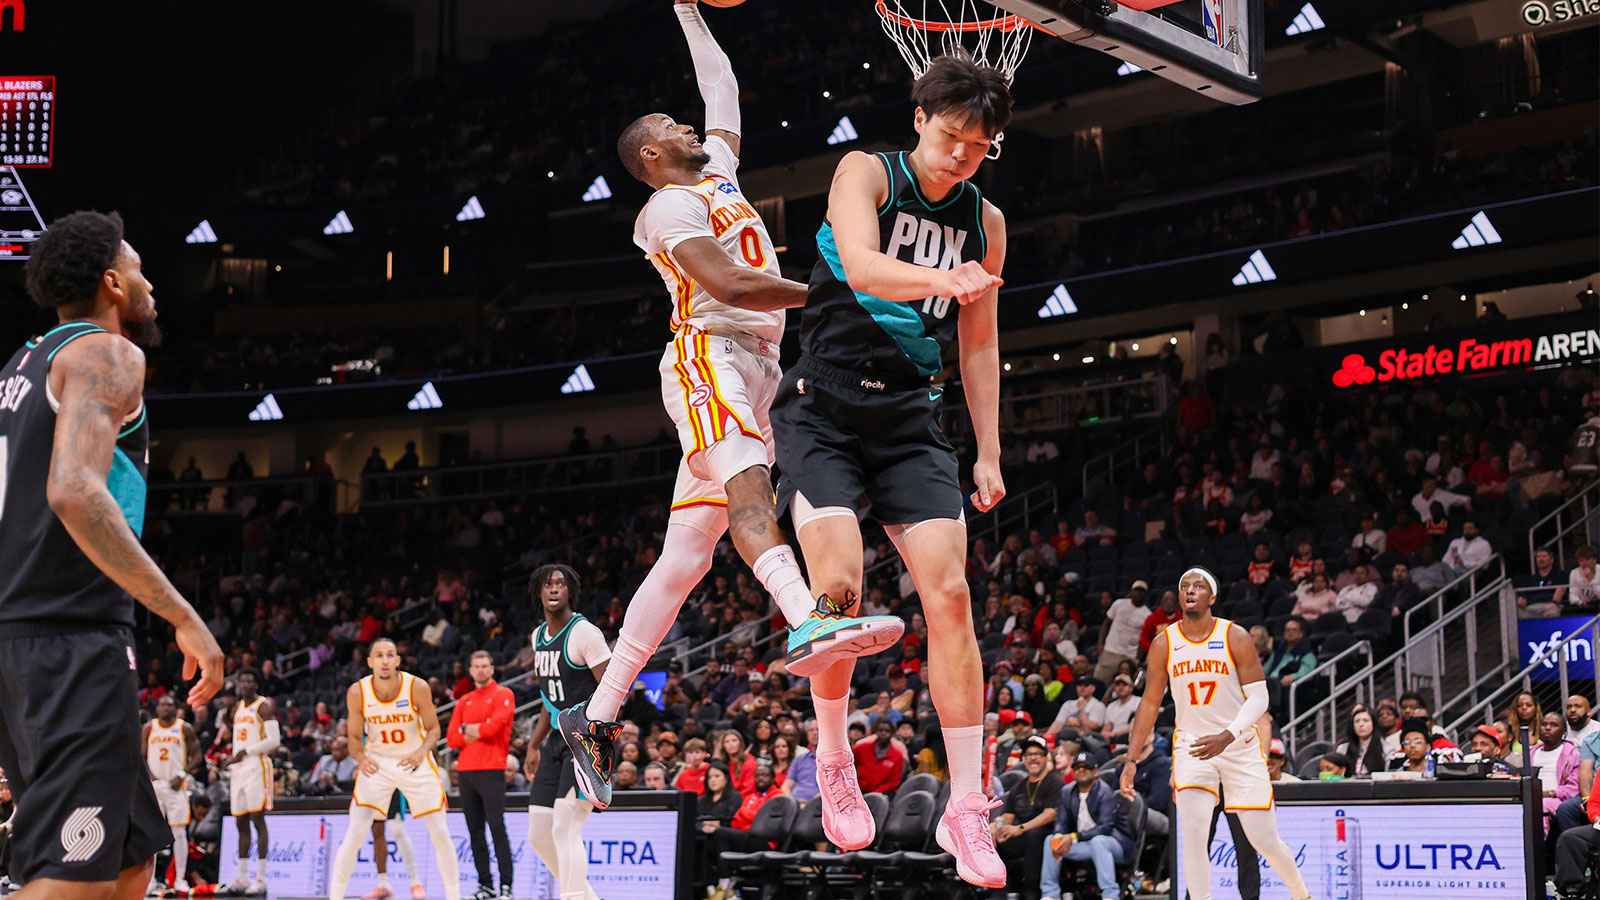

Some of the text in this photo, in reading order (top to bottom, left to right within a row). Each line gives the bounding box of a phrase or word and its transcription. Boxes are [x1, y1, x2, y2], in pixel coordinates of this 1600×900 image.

[4, 81, 43, 90] BLAZERS
[740, 226, 766, 269] 0
[886, 211, 968, 271] PDX
[1377, 345, 1454, 382] State
[1456, 338, 1533, 372] Farm
[860, 379, 885, 390] ripcity
[1577, 431, 1596, 447] 23
[534, 651, 561, 677] PDX
[1173, 659, 1229, 678] ATLANTA
[548, 679, 565, 702] 91
[1187, 680, 1218, 706] 17
[367, 713, 415, 725] ATLANTA
[380, 729, 406, 744] 10
[160, 748, 169, 761] 2
[583, 840, 657, 865] LTRA
[1375, 844, 1502, 870] ULTRA
[1376, 880, 1431, 888] SUPERIOR
[1478, 881, 1506, 889] BEER
